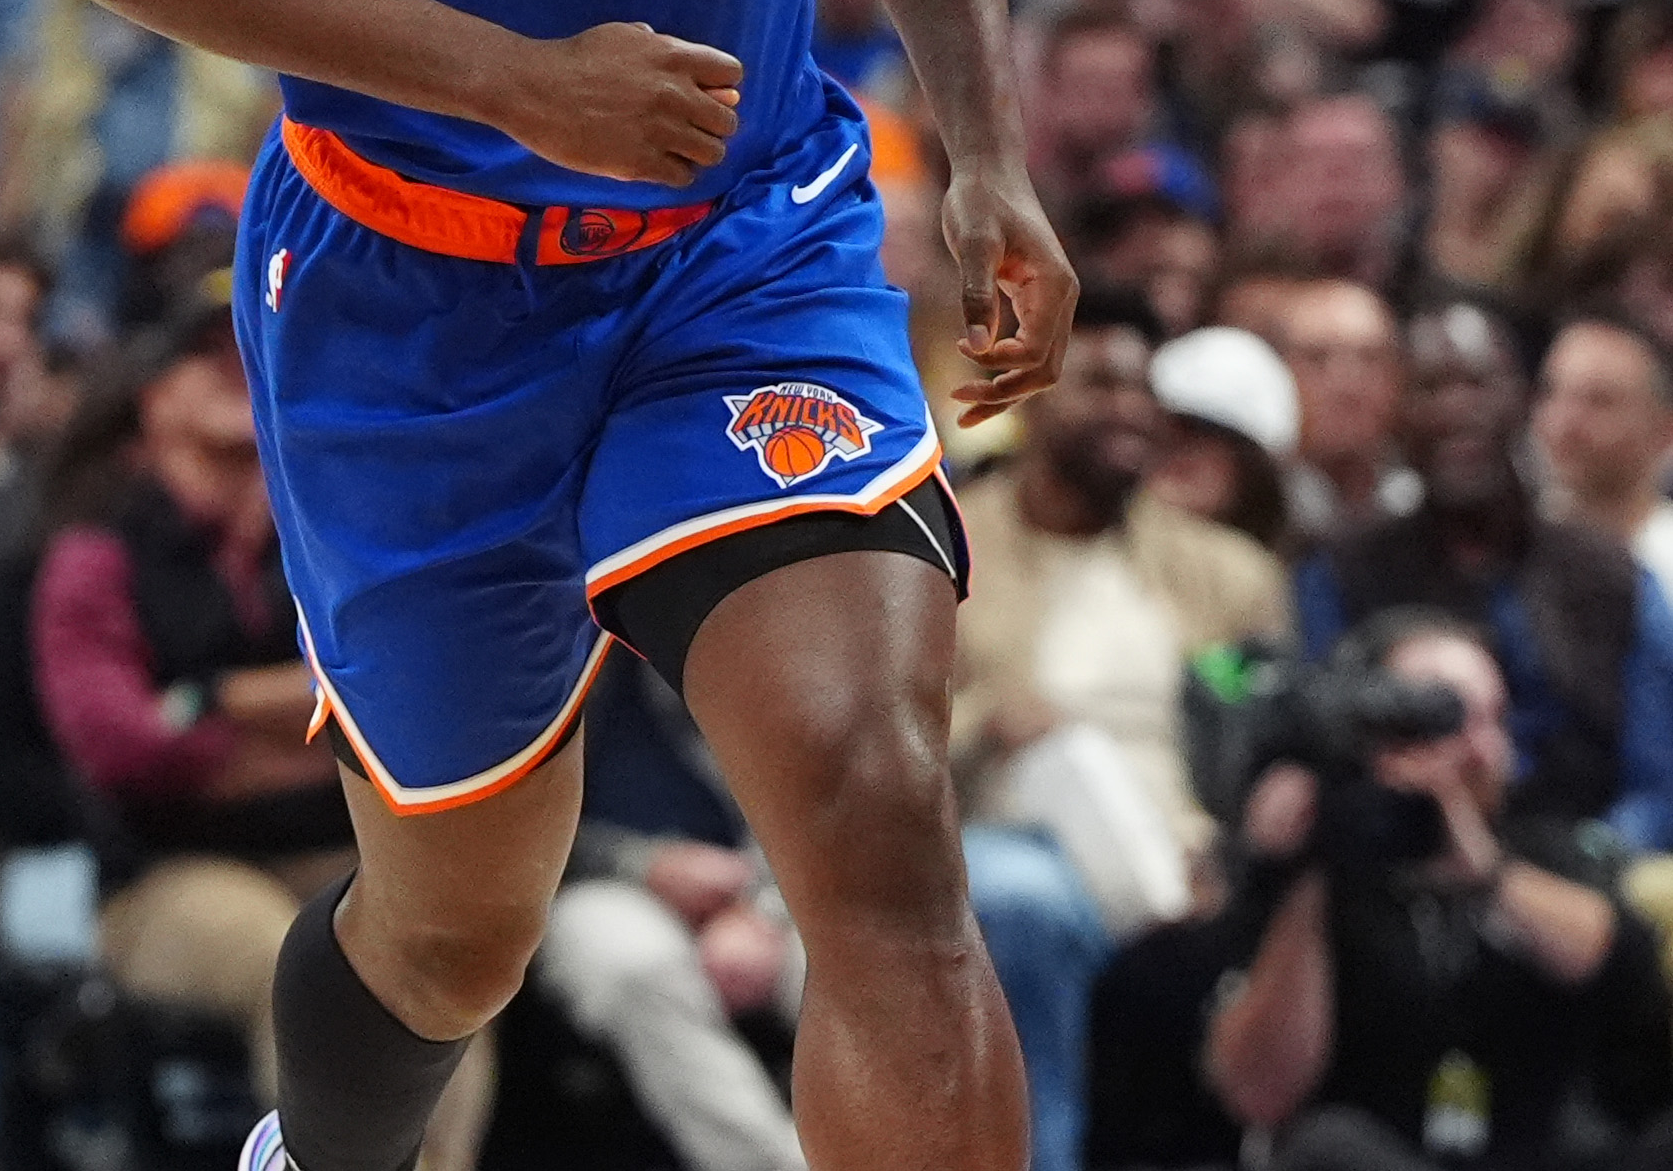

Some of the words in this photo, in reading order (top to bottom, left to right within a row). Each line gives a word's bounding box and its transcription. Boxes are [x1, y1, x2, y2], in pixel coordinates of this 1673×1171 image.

[779, 384, 804, 395] NEW
[807, 385, 833, 403] YORK
[732, 390, 865, 449] KNICKS
